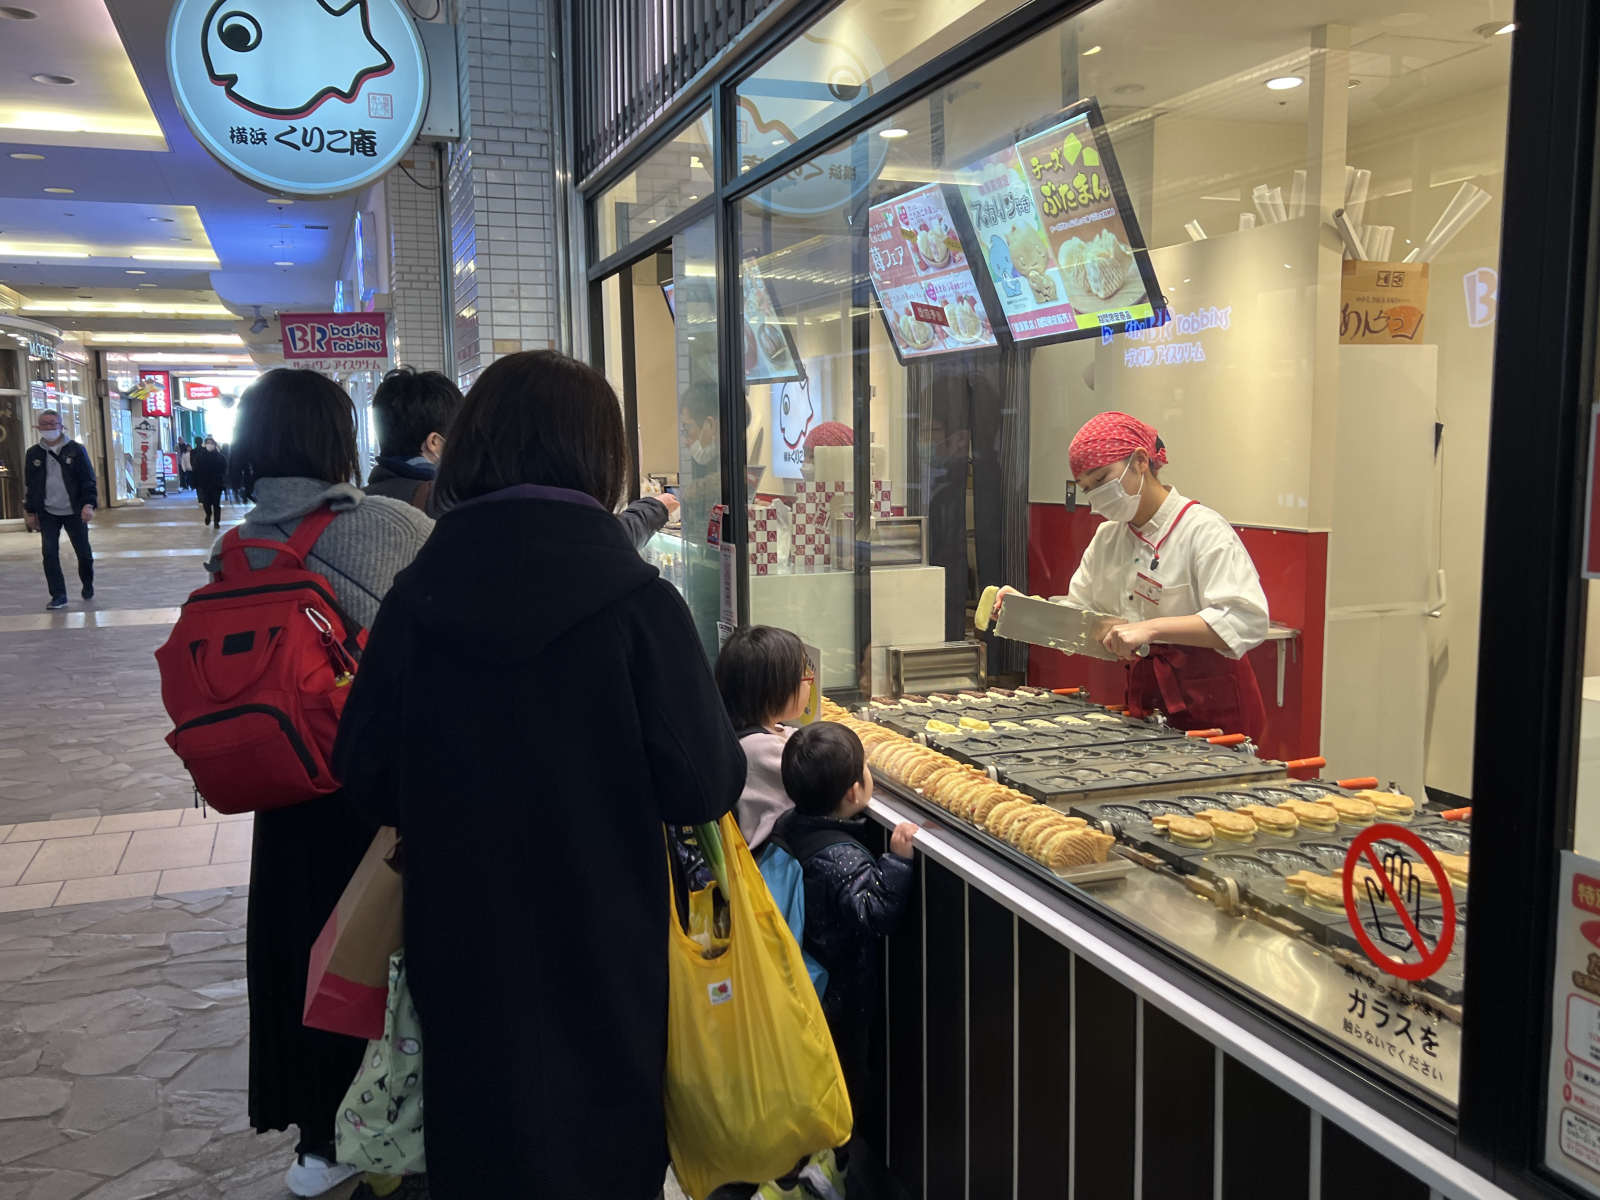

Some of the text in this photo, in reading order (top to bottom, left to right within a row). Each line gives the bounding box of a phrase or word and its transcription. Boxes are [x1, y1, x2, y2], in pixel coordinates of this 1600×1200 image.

[229, 125, 378, 157] 横浜 くりこ庵
[1030, 148, 1064, 179] チーズ
[1040, 171, 1110, 215] ぶたまん
[869, 246, 904, 272] 苺フェア
[328, 322, 380, 338] baskin
[1175, 305, 1232, 336] robbins
[331, 338, 382, 354] robbins
[334, 360, 381, 371] アイスクリーム
[1347, 988, 1440, 1058] ガラスを
[1342, 1018, 1444, 1082] 触らないでください
